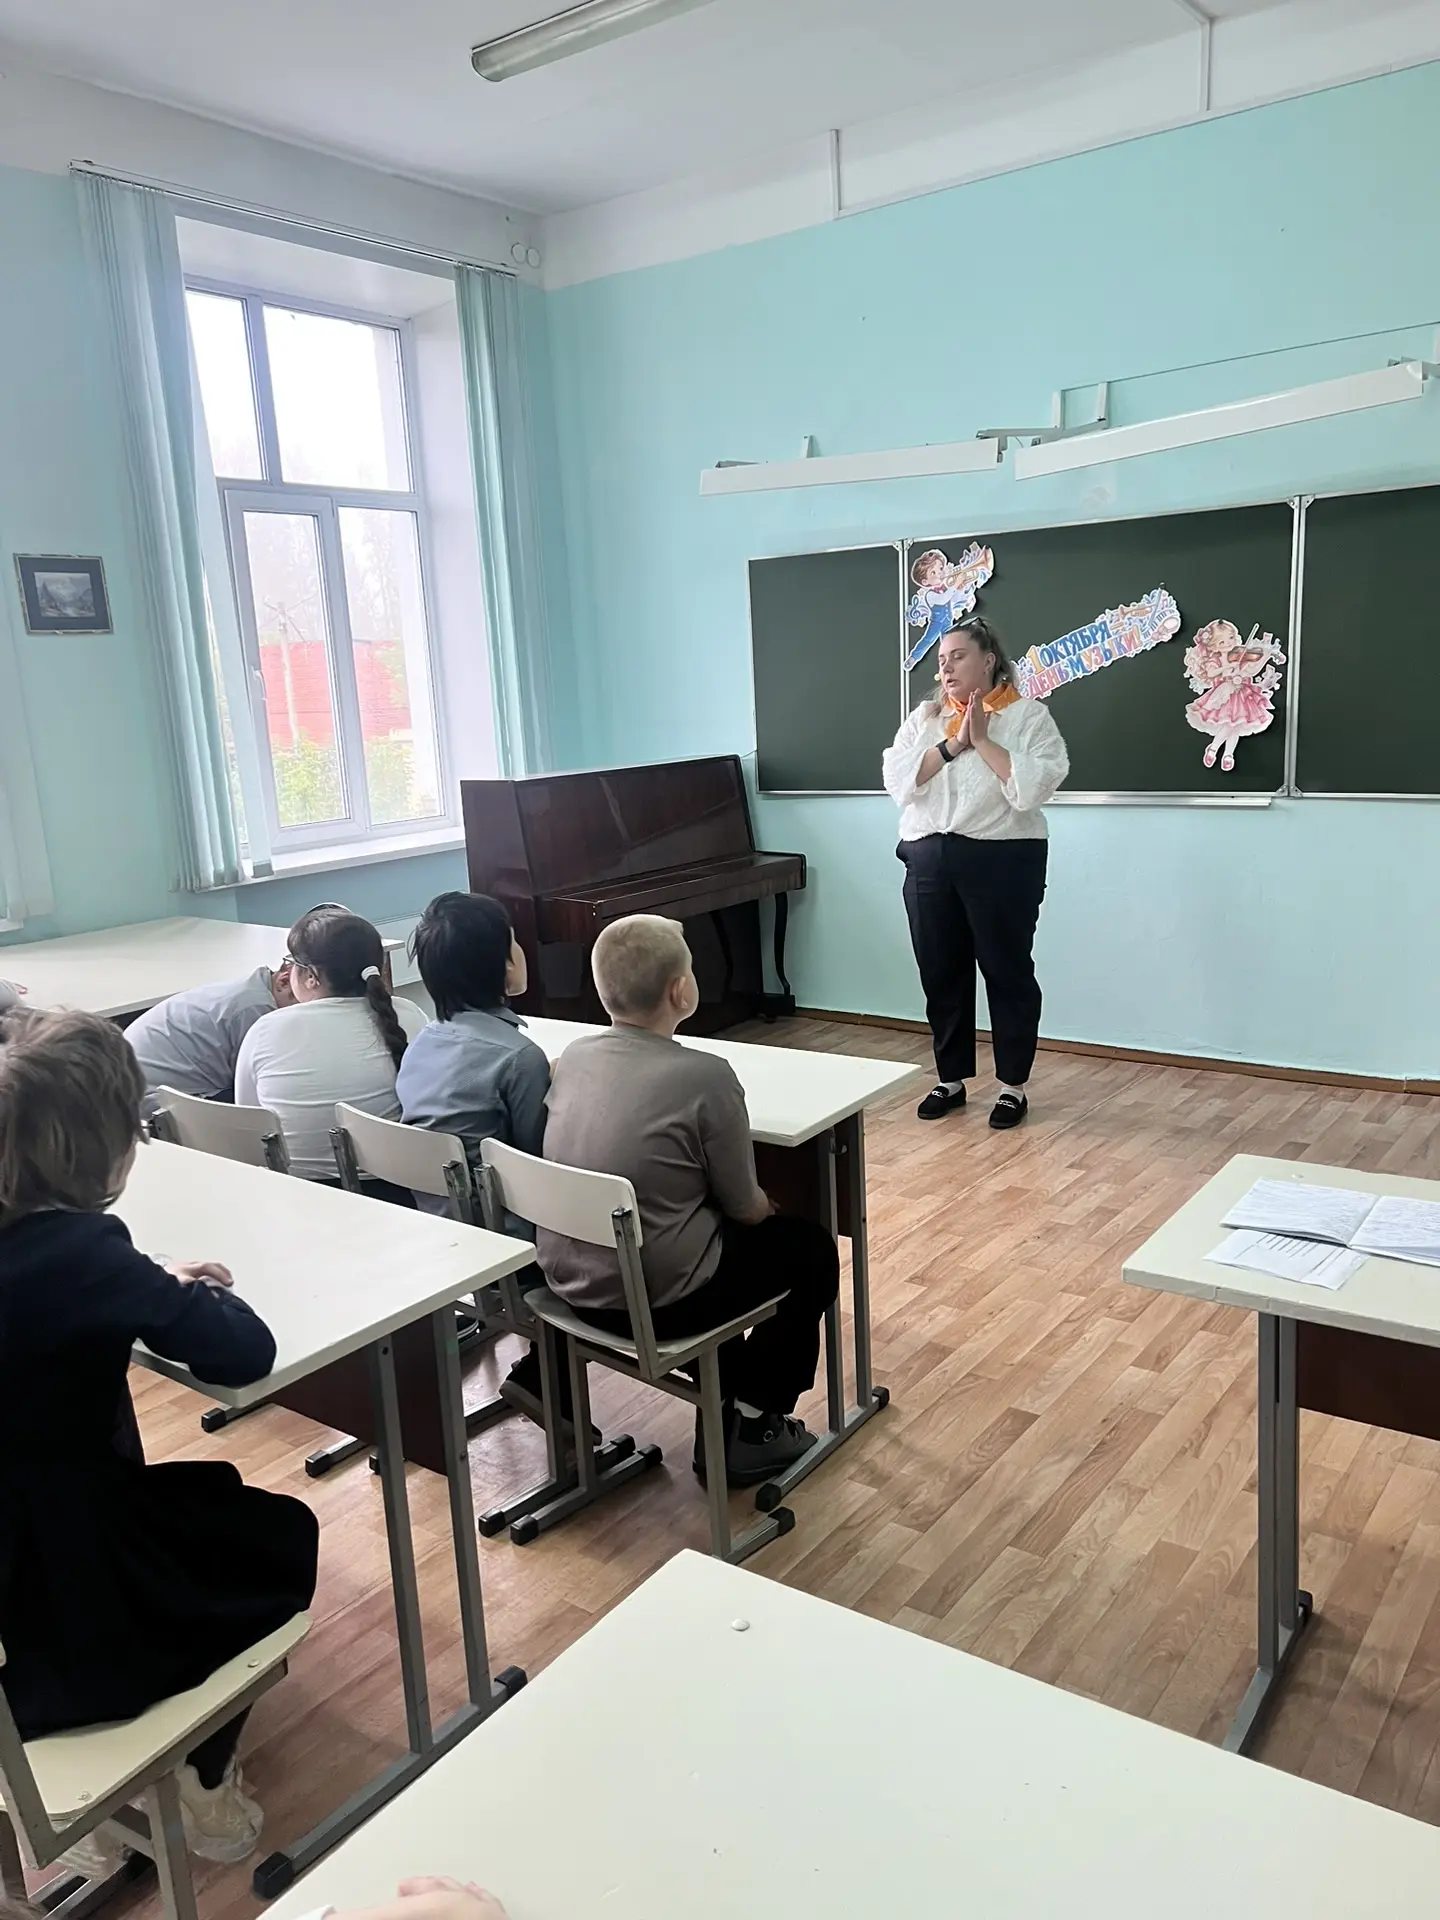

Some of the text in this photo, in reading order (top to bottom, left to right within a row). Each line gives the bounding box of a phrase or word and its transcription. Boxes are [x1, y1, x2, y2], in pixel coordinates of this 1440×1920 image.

[1026, 620, 1112, 674] 1 ОКТЯБРЯ
[1026, 625, 1142, 698] ДЕНЬ МУЗЫКИ!
